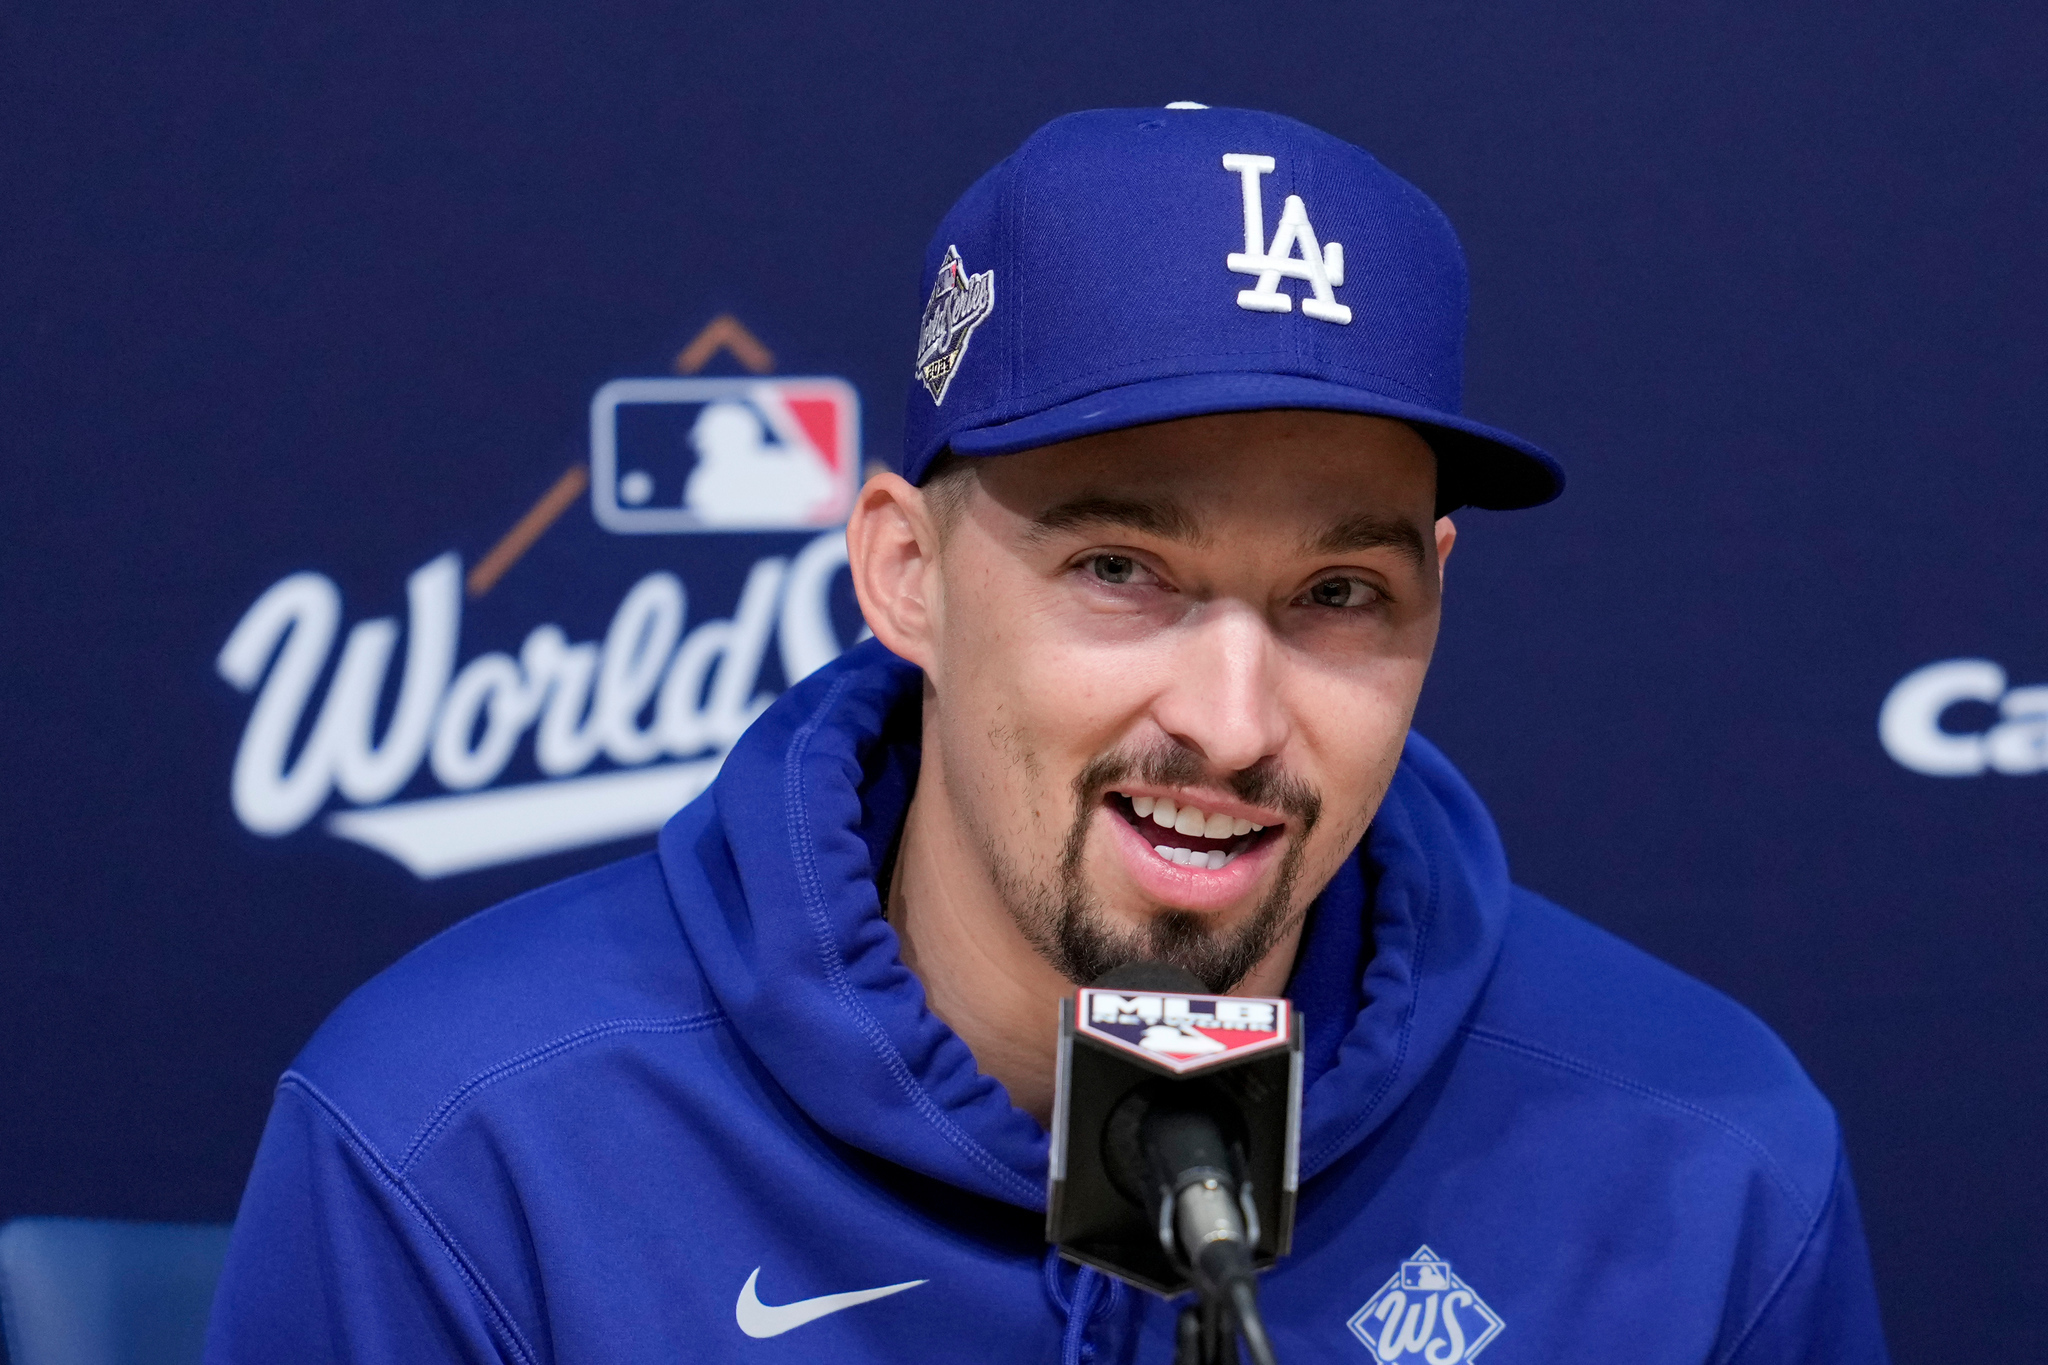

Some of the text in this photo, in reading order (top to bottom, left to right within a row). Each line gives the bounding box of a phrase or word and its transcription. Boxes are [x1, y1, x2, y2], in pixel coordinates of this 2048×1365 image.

[1222, 153, 1352, 325] LA
[216, 550, 789, 836] World
[1092, 993, 1275, 1025] MLB
[1374, 1290, 1473, 1365] WS
